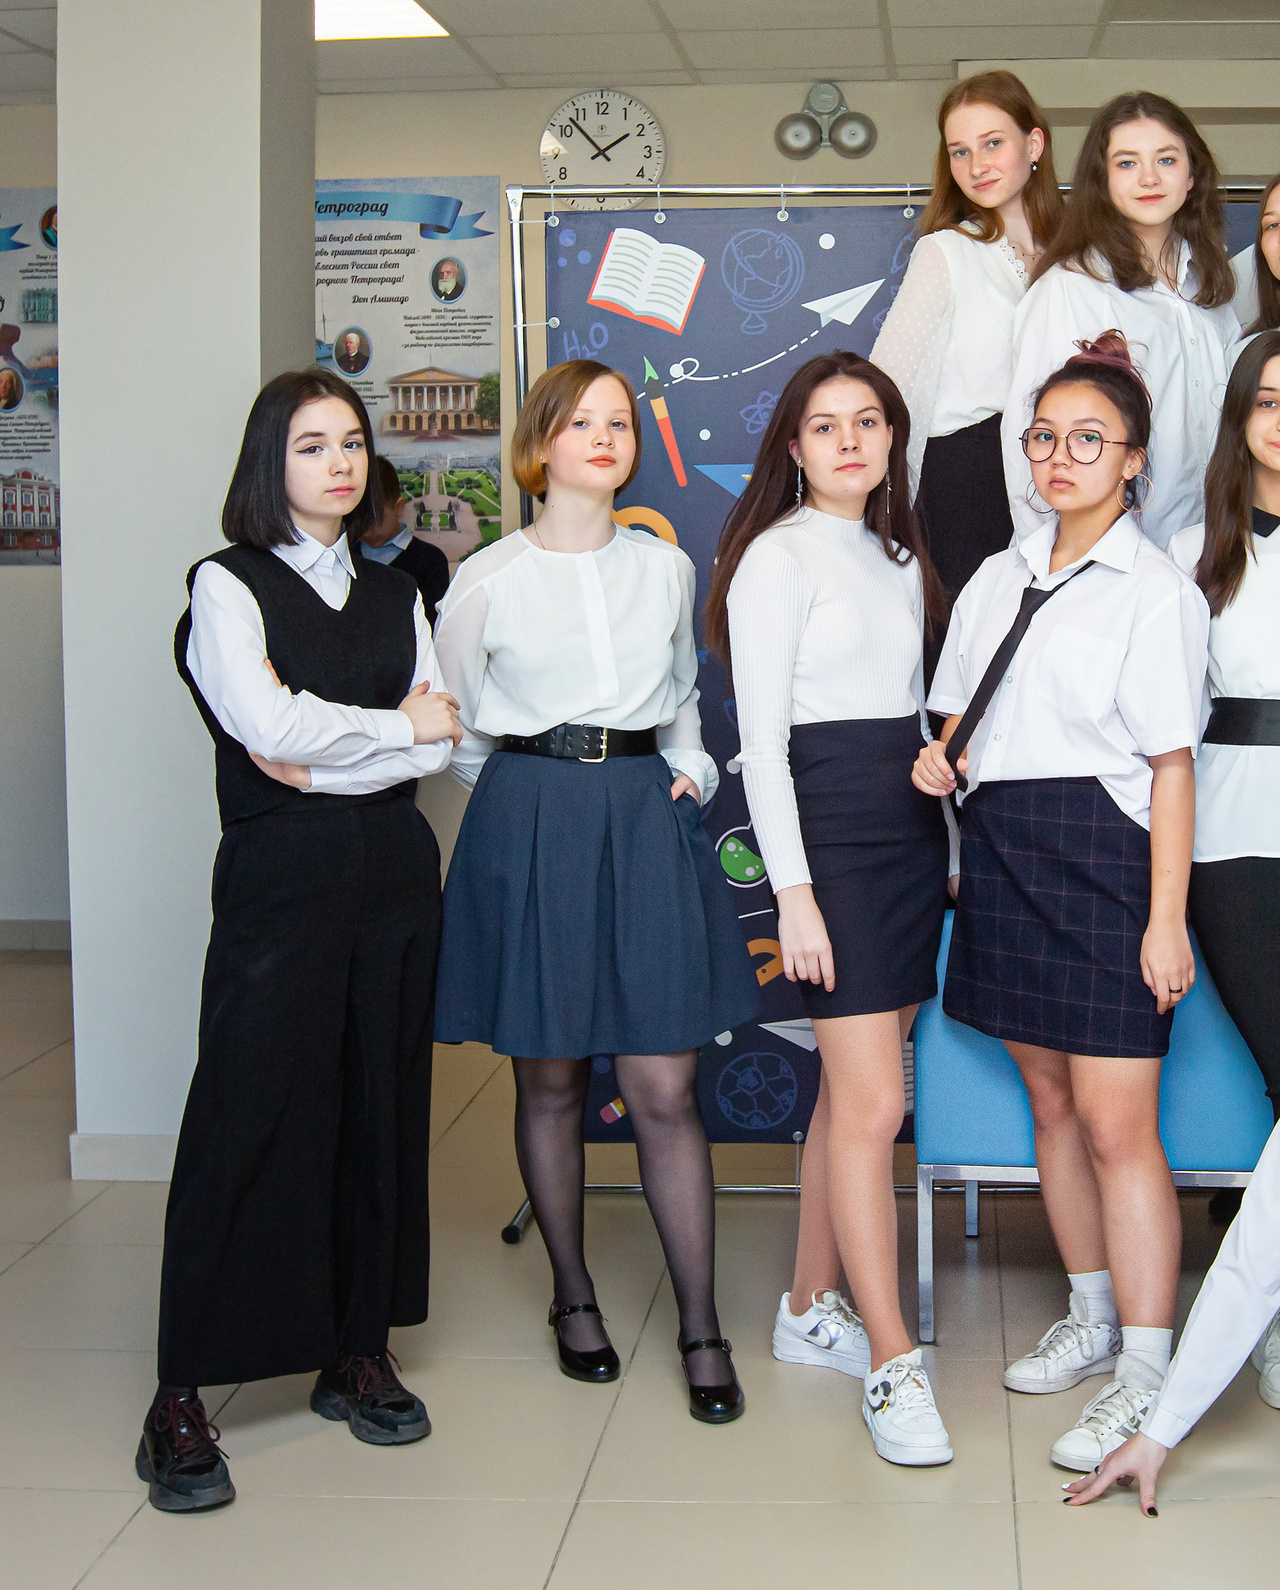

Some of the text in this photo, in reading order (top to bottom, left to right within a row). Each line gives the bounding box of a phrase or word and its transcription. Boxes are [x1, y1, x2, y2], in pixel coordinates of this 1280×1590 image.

[575, 108, 586, 121] 11
[595, 101, 609, 115] 12
[622, 107, 627, 120] 1
[559, 124, 573, 138] 10
[636, 123, 645, 137] 2
[552, 146, 560, 160] 9
[643, 145, 652, 159] 3
[558, 166, 568, 180] 8
[635, 165, 645, 179] 4
[328, 233, 354, 244] вызов
[355, 233, 373, 241] свой
[374, 232, 402, 241] ответ
[330, 248, 378, 258] гранитная
[379, 248, 416, 257] громада
[350, 261, 378, 270] России
[379, 260, 400, 269] свет
[316, 274, 405, 287] родного Петрограда!
[352, 294, 409, 305] Дон Аминадо
